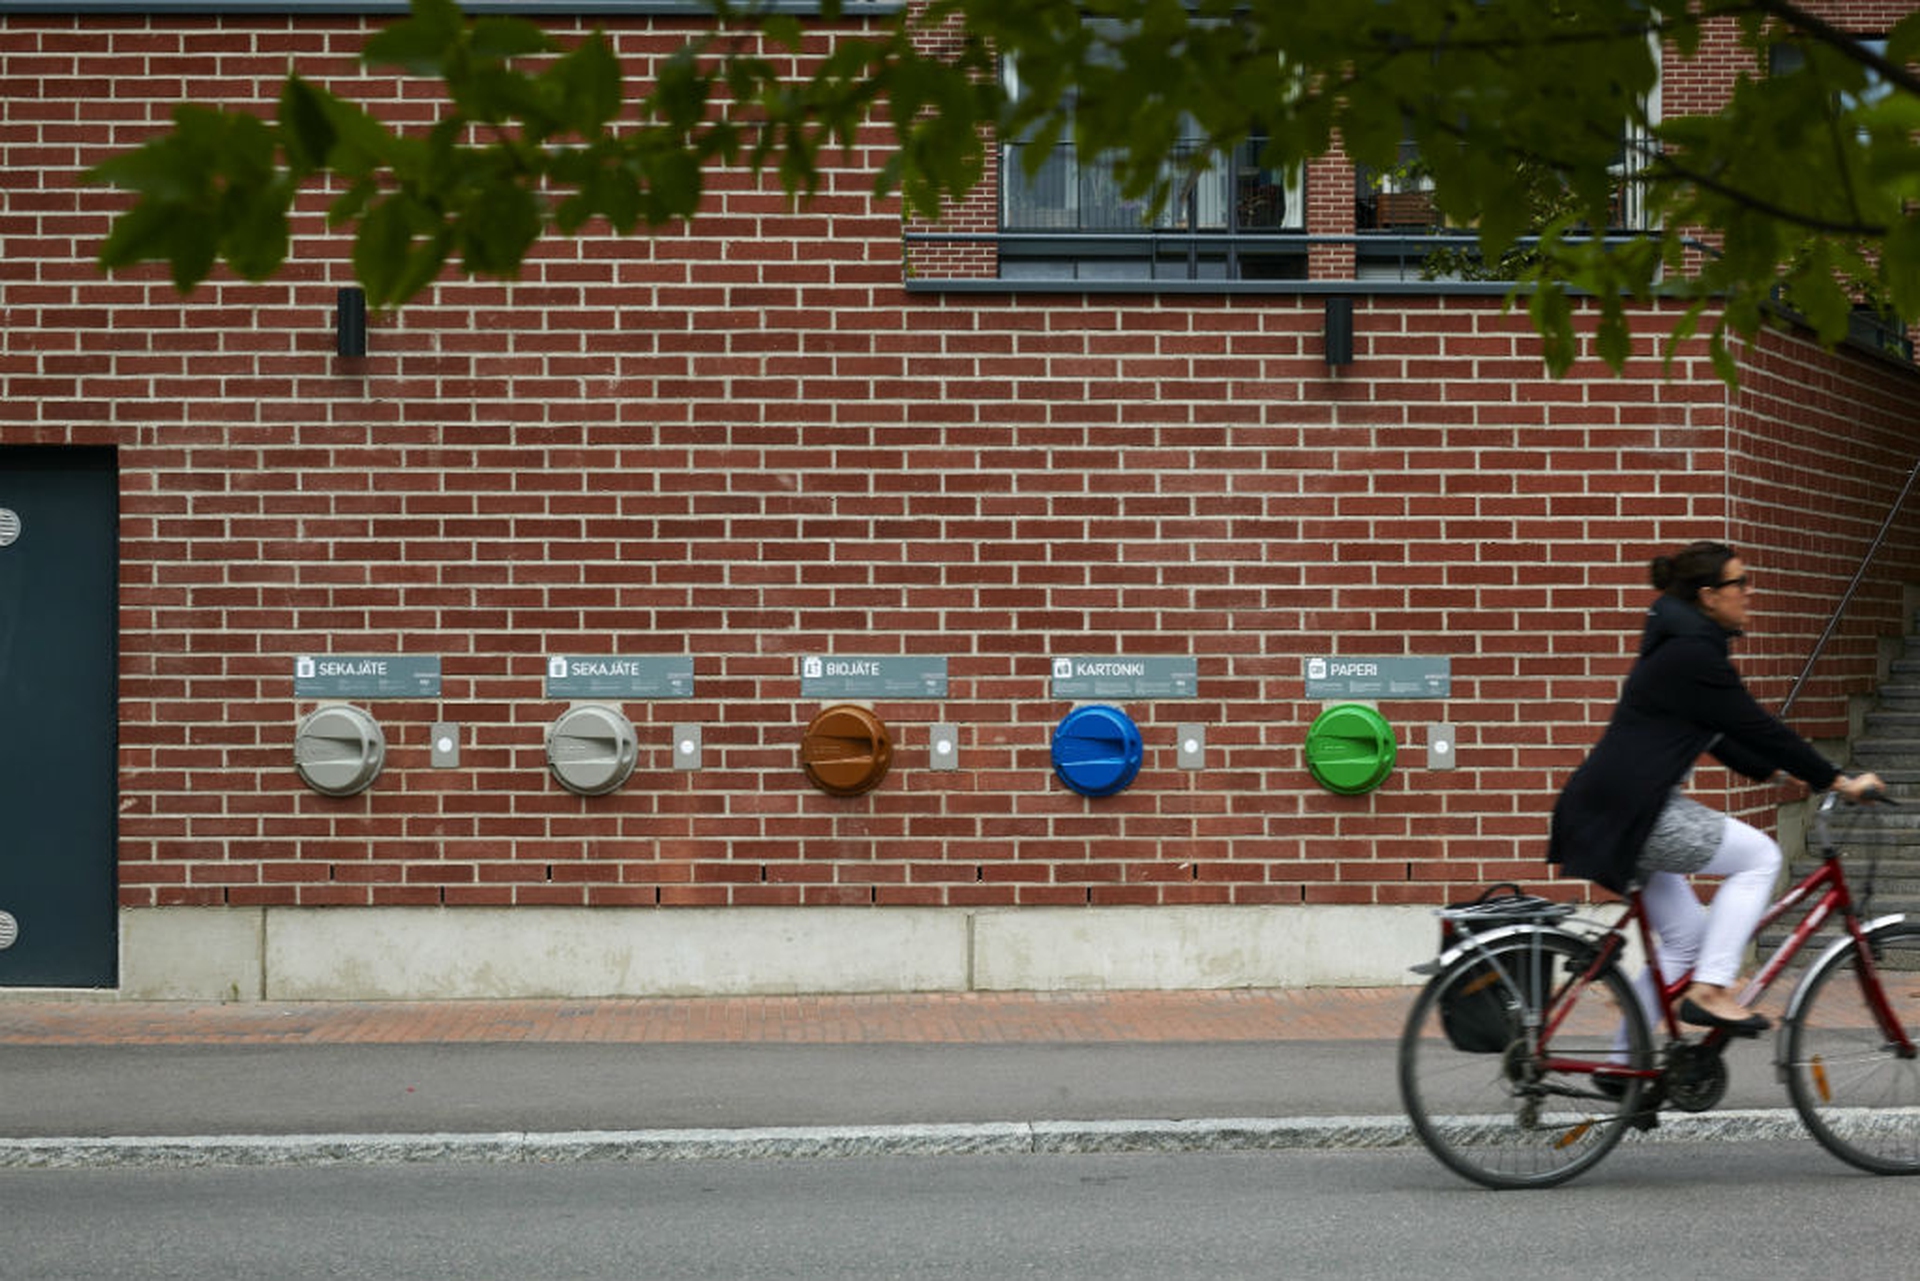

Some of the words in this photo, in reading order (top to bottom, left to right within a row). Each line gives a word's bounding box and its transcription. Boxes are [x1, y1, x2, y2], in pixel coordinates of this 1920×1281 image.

[319, 660, 388, 676] SEKAJÄTE
[571, 660, 640, 676] SEKAJÄTE
[826, 660, 880, 676] BIOJÄTE
[1077, 662, 1145, 676] KARTONKI
[1330, 663, 1378, 676] PAPERI
